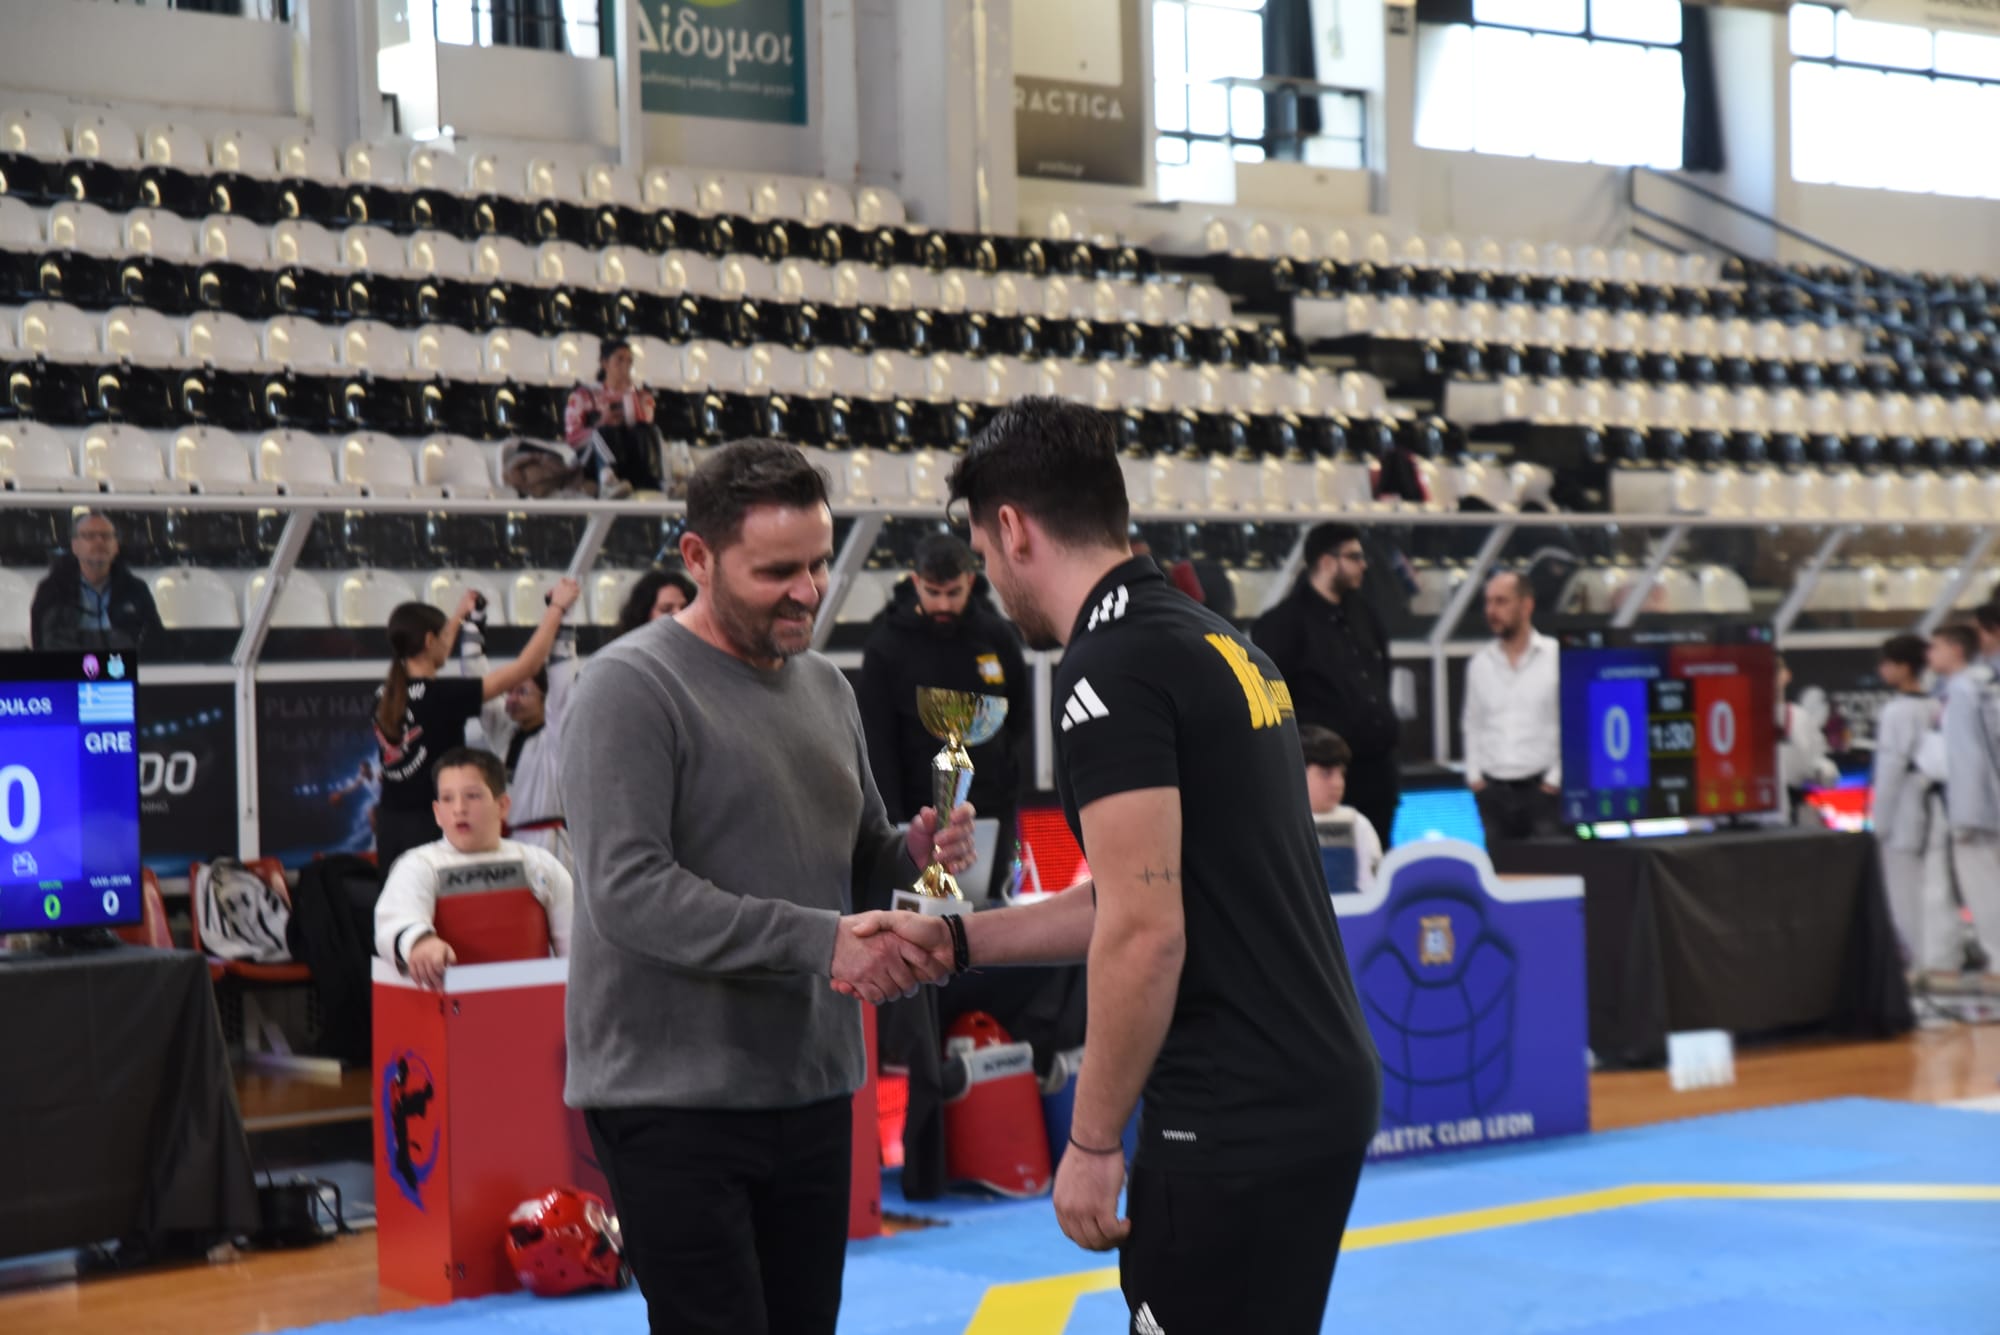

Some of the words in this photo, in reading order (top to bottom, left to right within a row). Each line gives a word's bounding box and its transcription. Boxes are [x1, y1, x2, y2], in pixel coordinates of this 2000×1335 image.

[1011, 86, 1124, 120] RACTICA
[264, 695, 322, 720] PLAY
[84, 731, 133, 754] GRE
[1603, 705, 1631, 762] 0
[1650, 720, 1695, 750] 1:30
[1709, 699, 1736, 756] 0
[0, 763, 42, 844] 0
[446, 865, 518, 888] KPNP
[43, 893, 61, 920] 0
[102, 889, 120, 916] 0
[1436, 1118, 1484, 1145] CLUB
[1485, 1111, 1536, 1141] LEON
